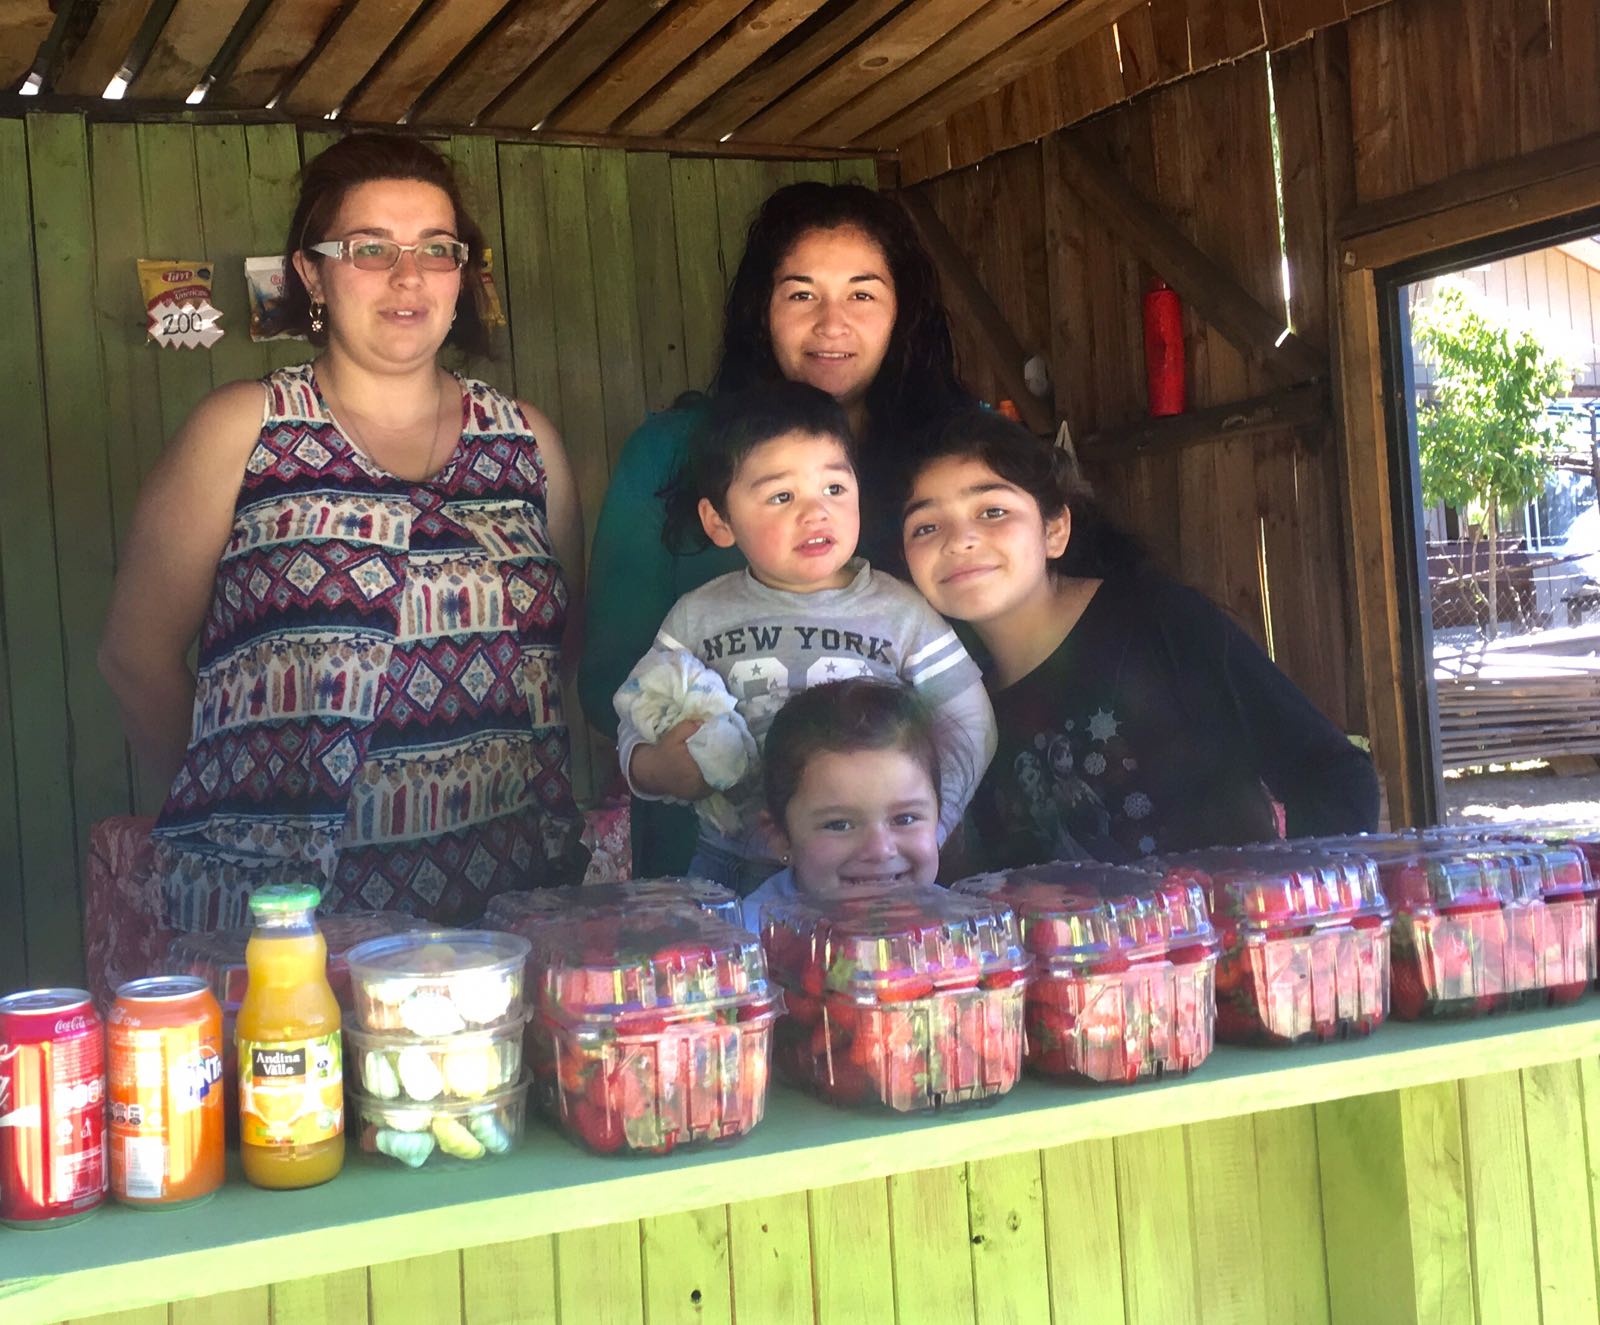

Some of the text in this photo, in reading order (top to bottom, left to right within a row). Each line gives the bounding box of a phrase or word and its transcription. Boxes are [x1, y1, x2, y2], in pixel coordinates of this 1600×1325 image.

[162, 312, 202, 335] 200
[703, 626, 893, 665] NEW YORK
[256, 1051, 301, 1064] Andina
